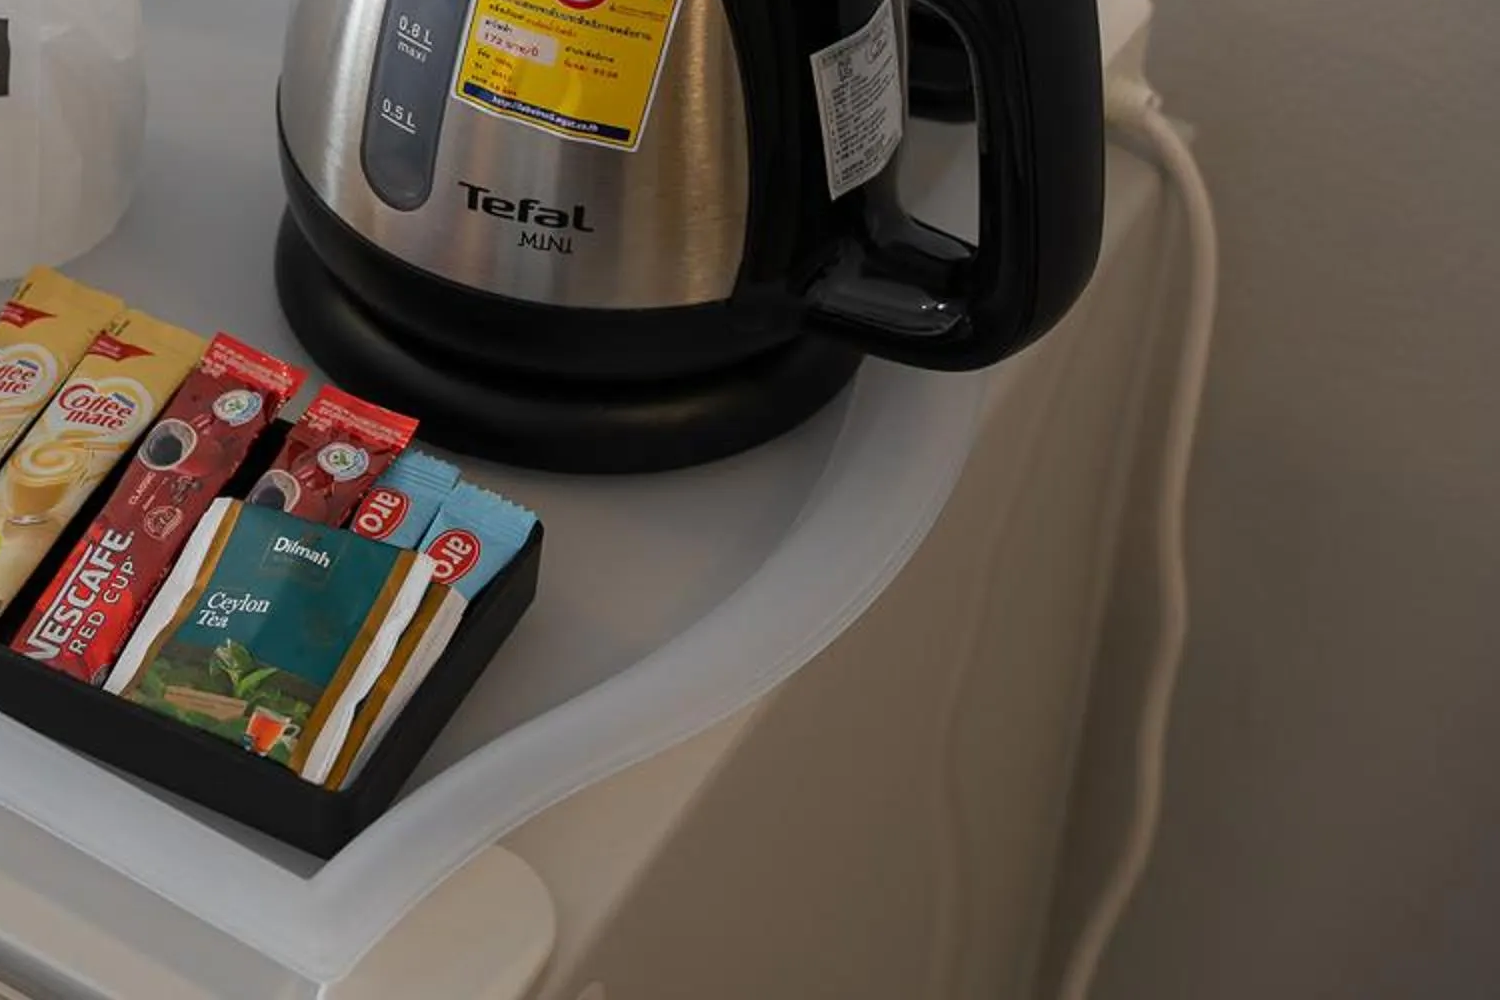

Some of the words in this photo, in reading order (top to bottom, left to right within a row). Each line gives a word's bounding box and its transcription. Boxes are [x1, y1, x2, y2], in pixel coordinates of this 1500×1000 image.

[398, 14, 421, 38] 0.8
[423, 29, 433, 46] L
[382, 97, 404, 121] 0.5
[406, 111, 416, 129] L
[457, 180, 595, 233] Tefal
[517, 230, 574, 255] MINI
[58, 383, 136, 418] Coffee
[63, 409, 126, 431] mate
[358, 491, 401, 534] aro
[273, 536, 331, 569] Dilmah
[433, 535, 473, 579] aro
[68, 610, 105, 655] RED
[103, 560, 135, 604] CUP
[195, 609, 229, 629] Tea
[207, 591, 271, 615] Ceylon
